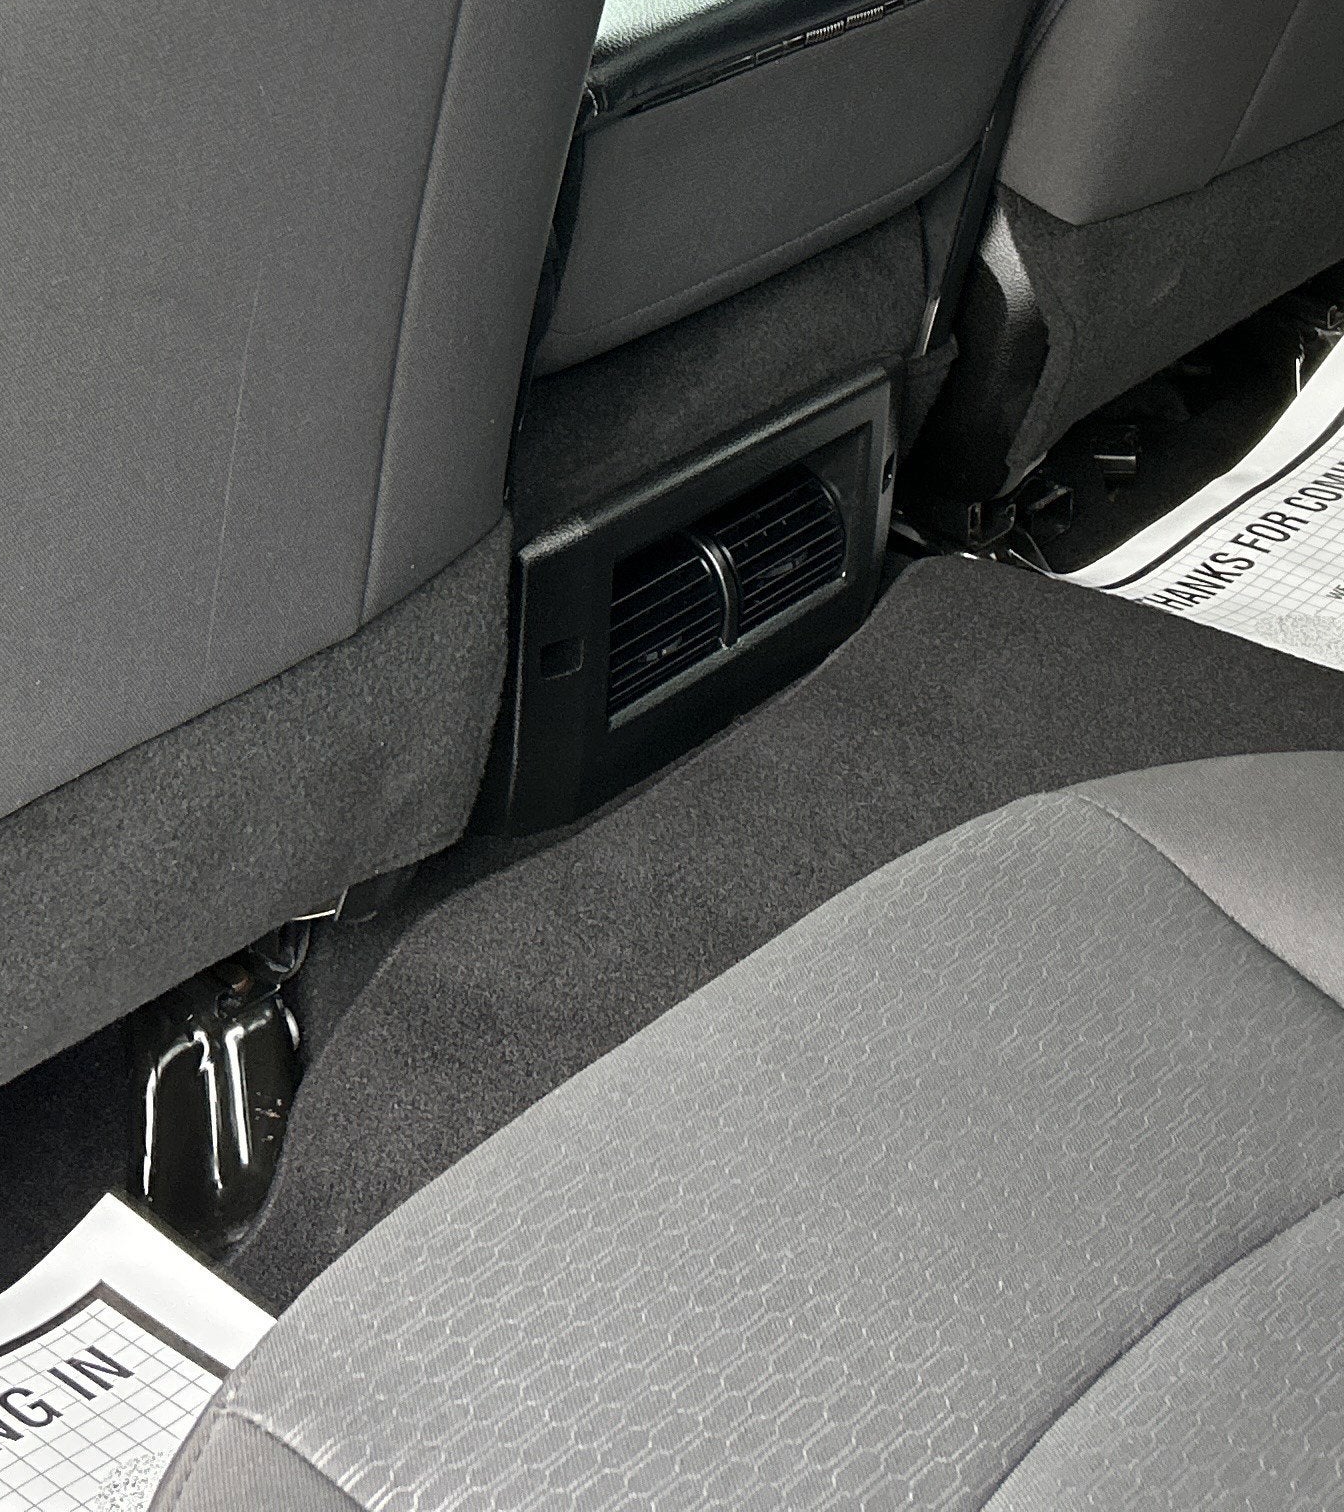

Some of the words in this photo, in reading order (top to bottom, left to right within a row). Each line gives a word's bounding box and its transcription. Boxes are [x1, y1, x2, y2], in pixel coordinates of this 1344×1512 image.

[1135, 552, 1255, 611] HANKS
[1229, 511, 1309, 554] FOR
[47, 1346, 135, 1401] IN
